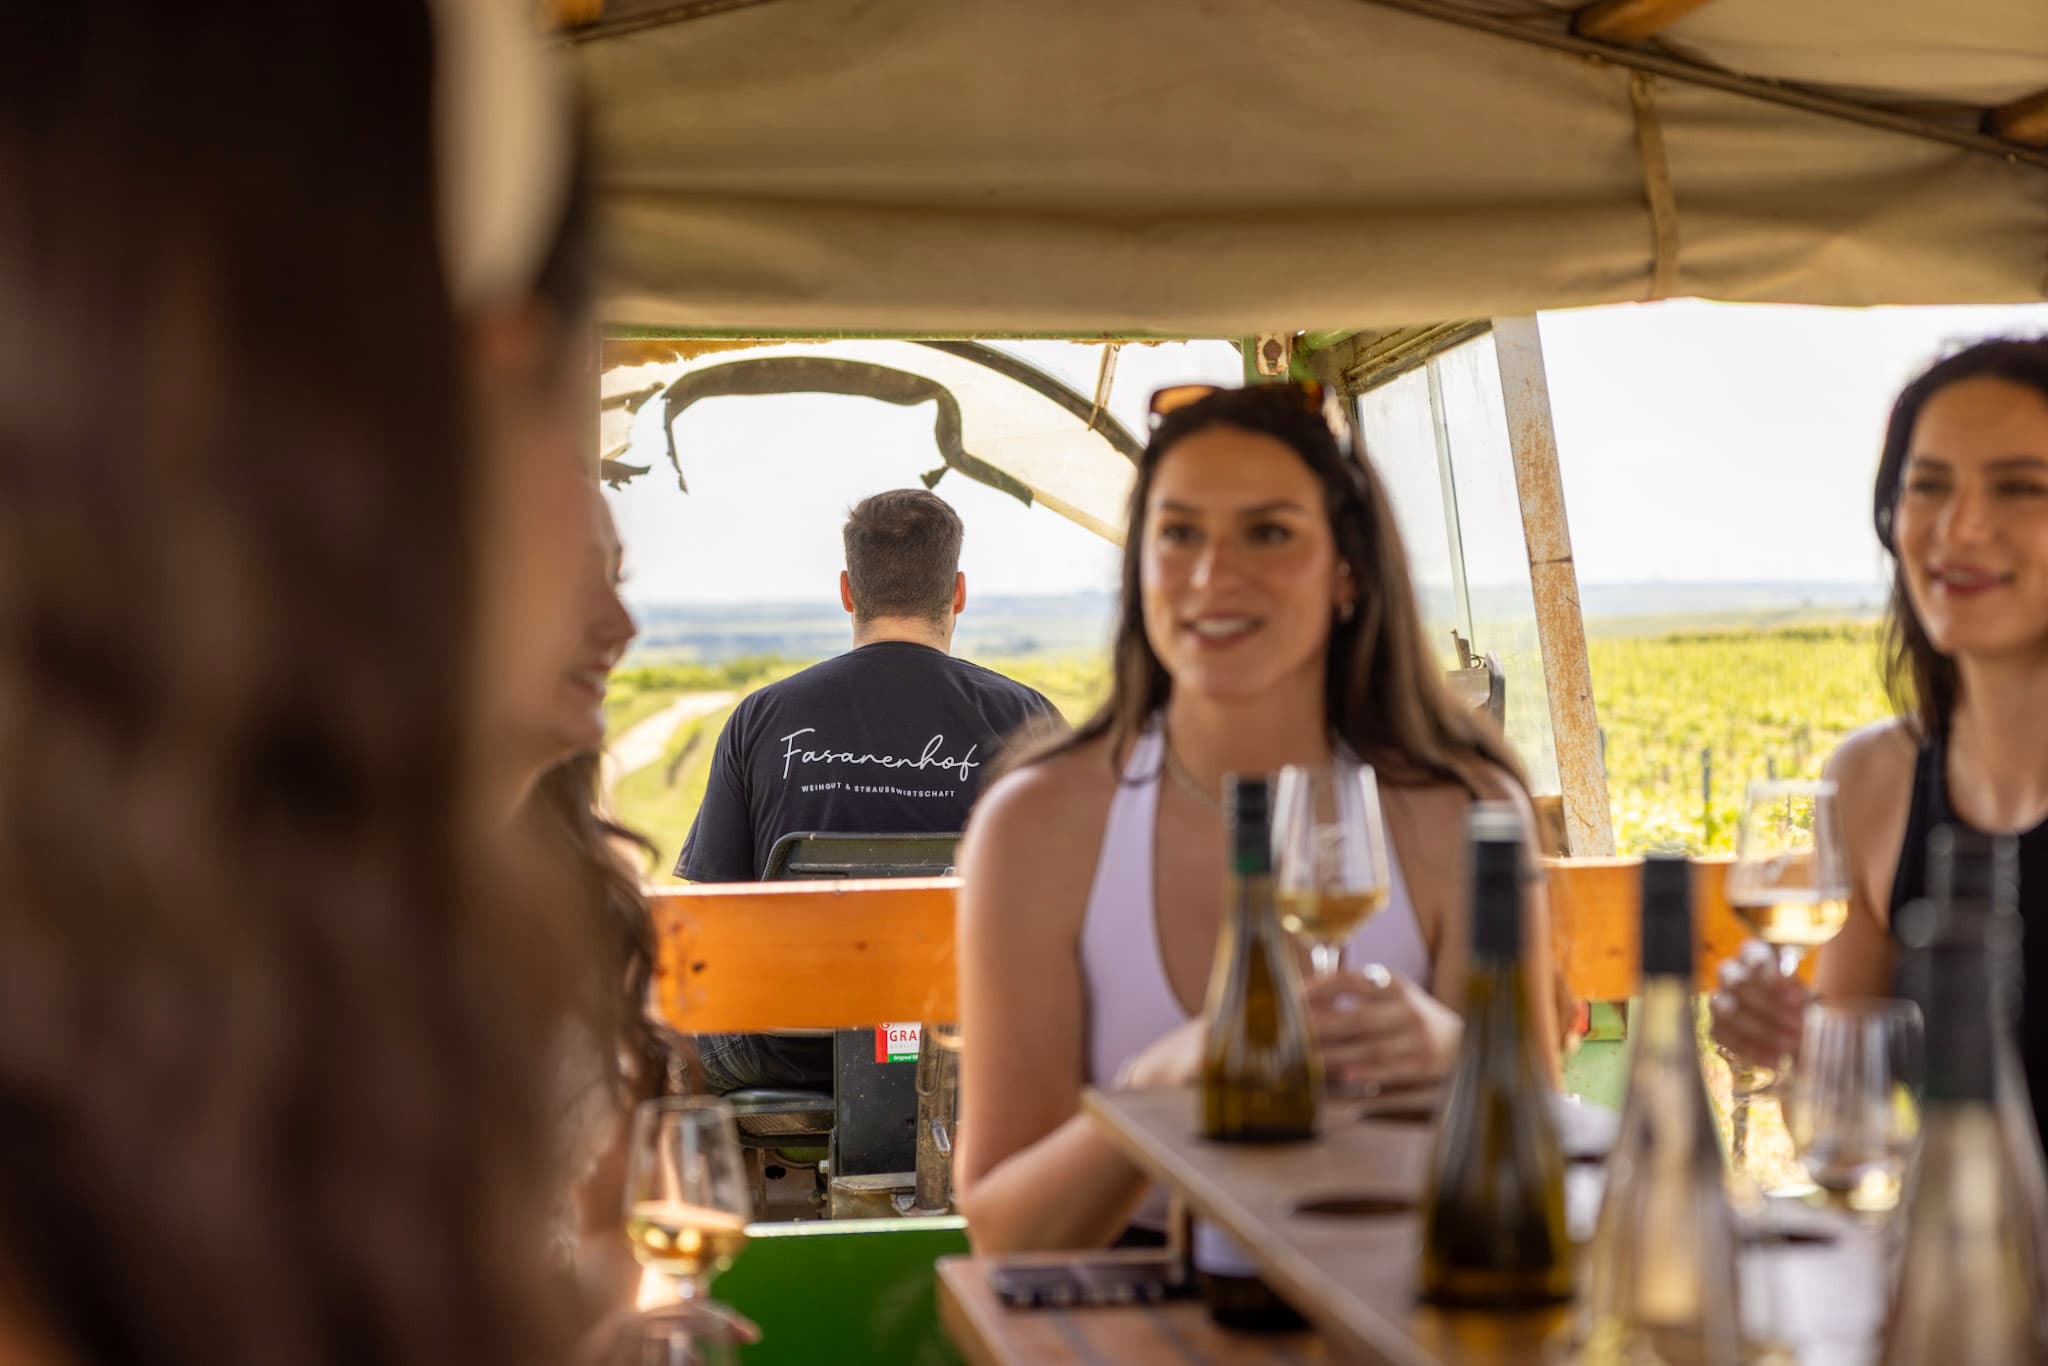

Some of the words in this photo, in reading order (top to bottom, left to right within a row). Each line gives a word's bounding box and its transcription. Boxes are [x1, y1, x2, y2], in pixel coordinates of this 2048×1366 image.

[780, 727, 980, 782] Fasanenhof
[801, 782, 842, 793] WEINGUT
[854, 785, 956, 798] STRAUSSWIRTSCHAFT
